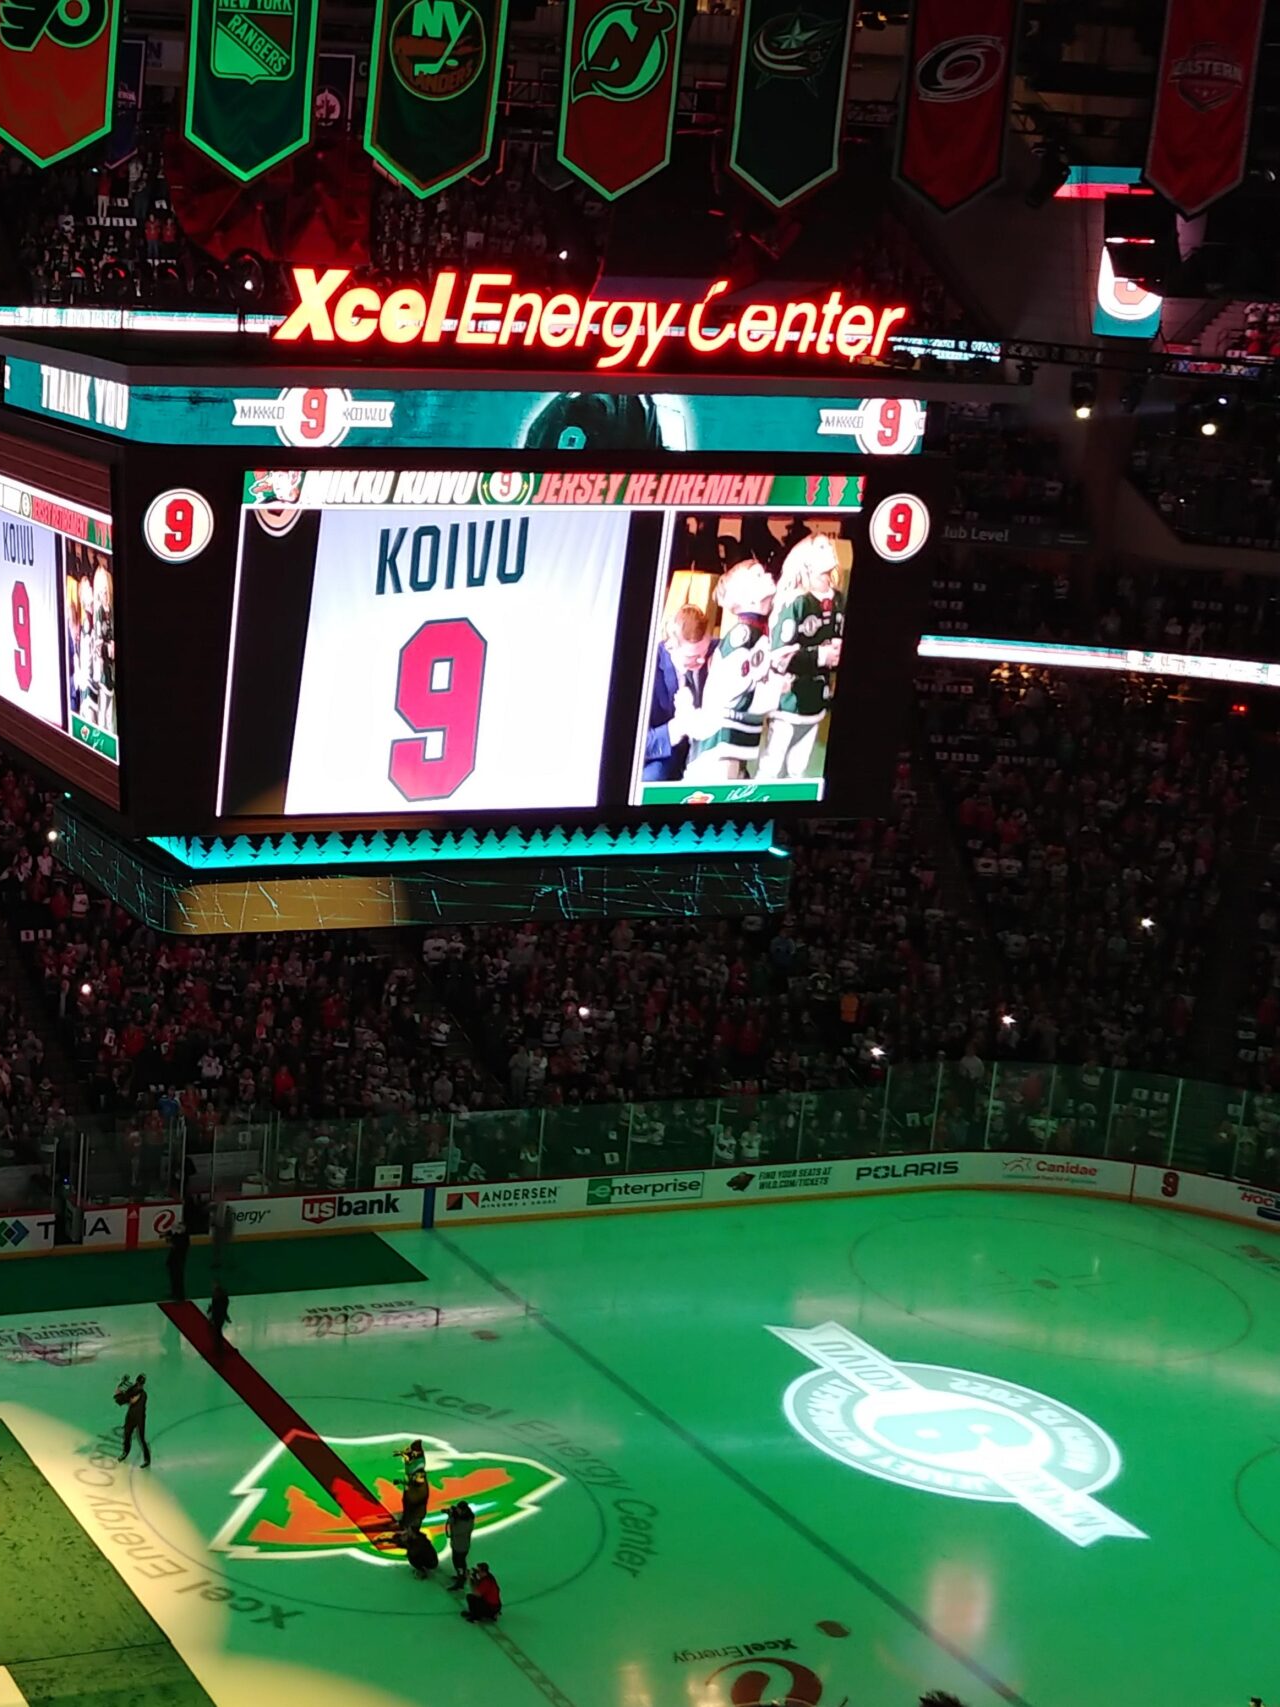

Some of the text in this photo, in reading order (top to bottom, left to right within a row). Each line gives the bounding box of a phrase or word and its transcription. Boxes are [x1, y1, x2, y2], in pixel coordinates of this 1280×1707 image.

[256, 0, 292, 11] YORK
[227, 14, 287, 73] RANGERS
[687, 280, 907, 358] Center
[300, 388, 328, 440] 9
[877, 399, 902, 447] 9
[393, 471, 477, 504] KOIVU
[533, 472, 625, 504] JERSEY
[622, 473, 775, 505] RETIREMENT
[2, 521, 35, 566] KOIVU
[164, 498, 194, 552] 9
[887, 503, 913, 552] 9
[943, 526, 1010, 542] lub Level
[375, 516, 530, 596] KOIVU
[11, 580, 33, 692] 9
[388, 616, 488, 802] 9
[856, 1161, 959, 1181] POLARIS
[1036, 1160, 1098, 1177] Canidae
[1161, 1172, 1180, 1198] 9
[481, 1186, 558, 1203] ANDERSEN
[593, 1179, 702, 1199] enterprise
[36, 1217, 111, 1240] TIA
[230, 1208, 267, 1225] nergy
[305, 1303, 366, 1314] SUGAR
[32, 1325, 107, 1343] Treasure
[811, 1339, 913, 1393] KOIVU
[398, 1384, 660, 1578] Xcel Energy Center
[74, 1424, 305, 1630] Xcel Energy Cente
[673, 1638, 798, 1664] Xcel Energy
